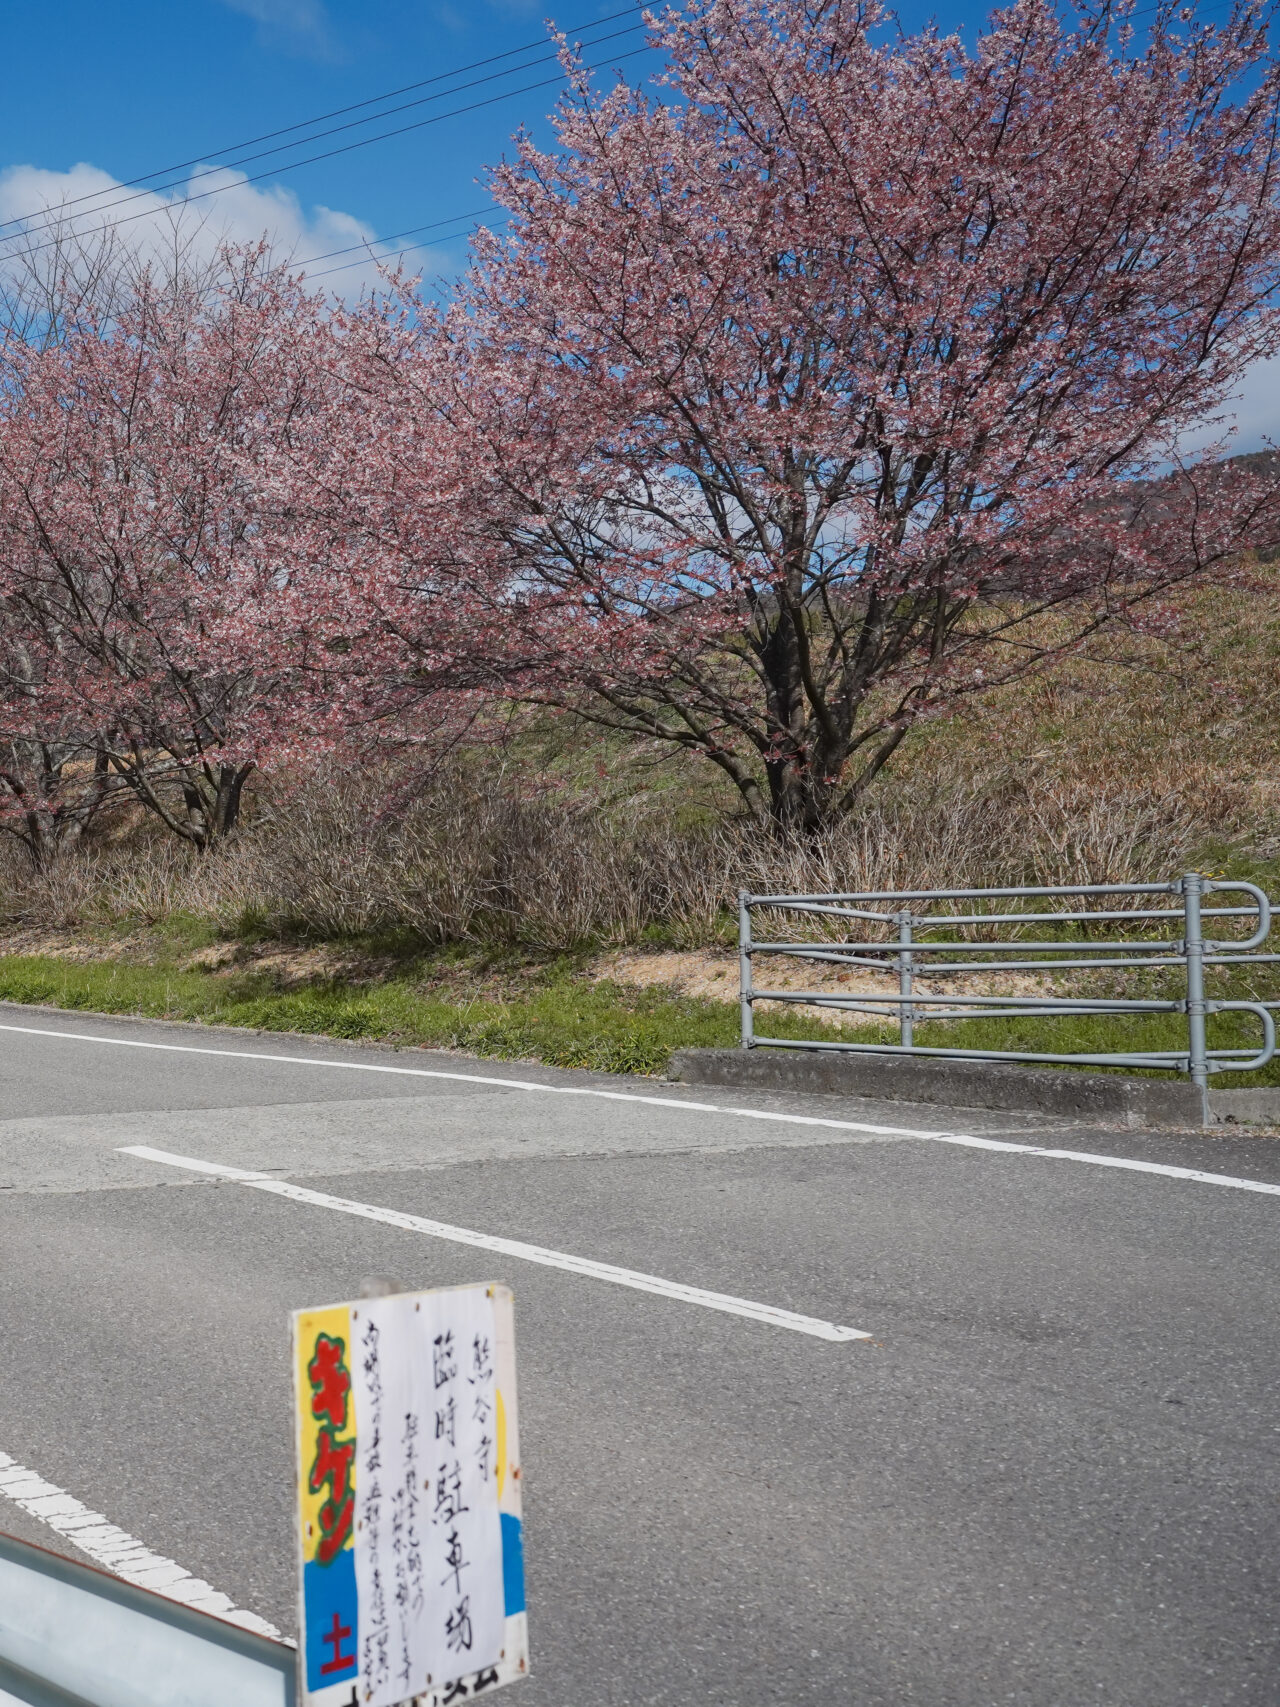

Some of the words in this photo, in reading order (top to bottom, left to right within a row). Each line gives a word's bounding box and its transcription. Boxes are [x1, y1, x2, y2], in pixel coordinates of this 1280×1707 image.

[307, 1331, 357, 1568] キケン
[430, 1331, 474, 1652] 臨時駐車場
[467, 1331, 494, 1484] 熊谷寺
